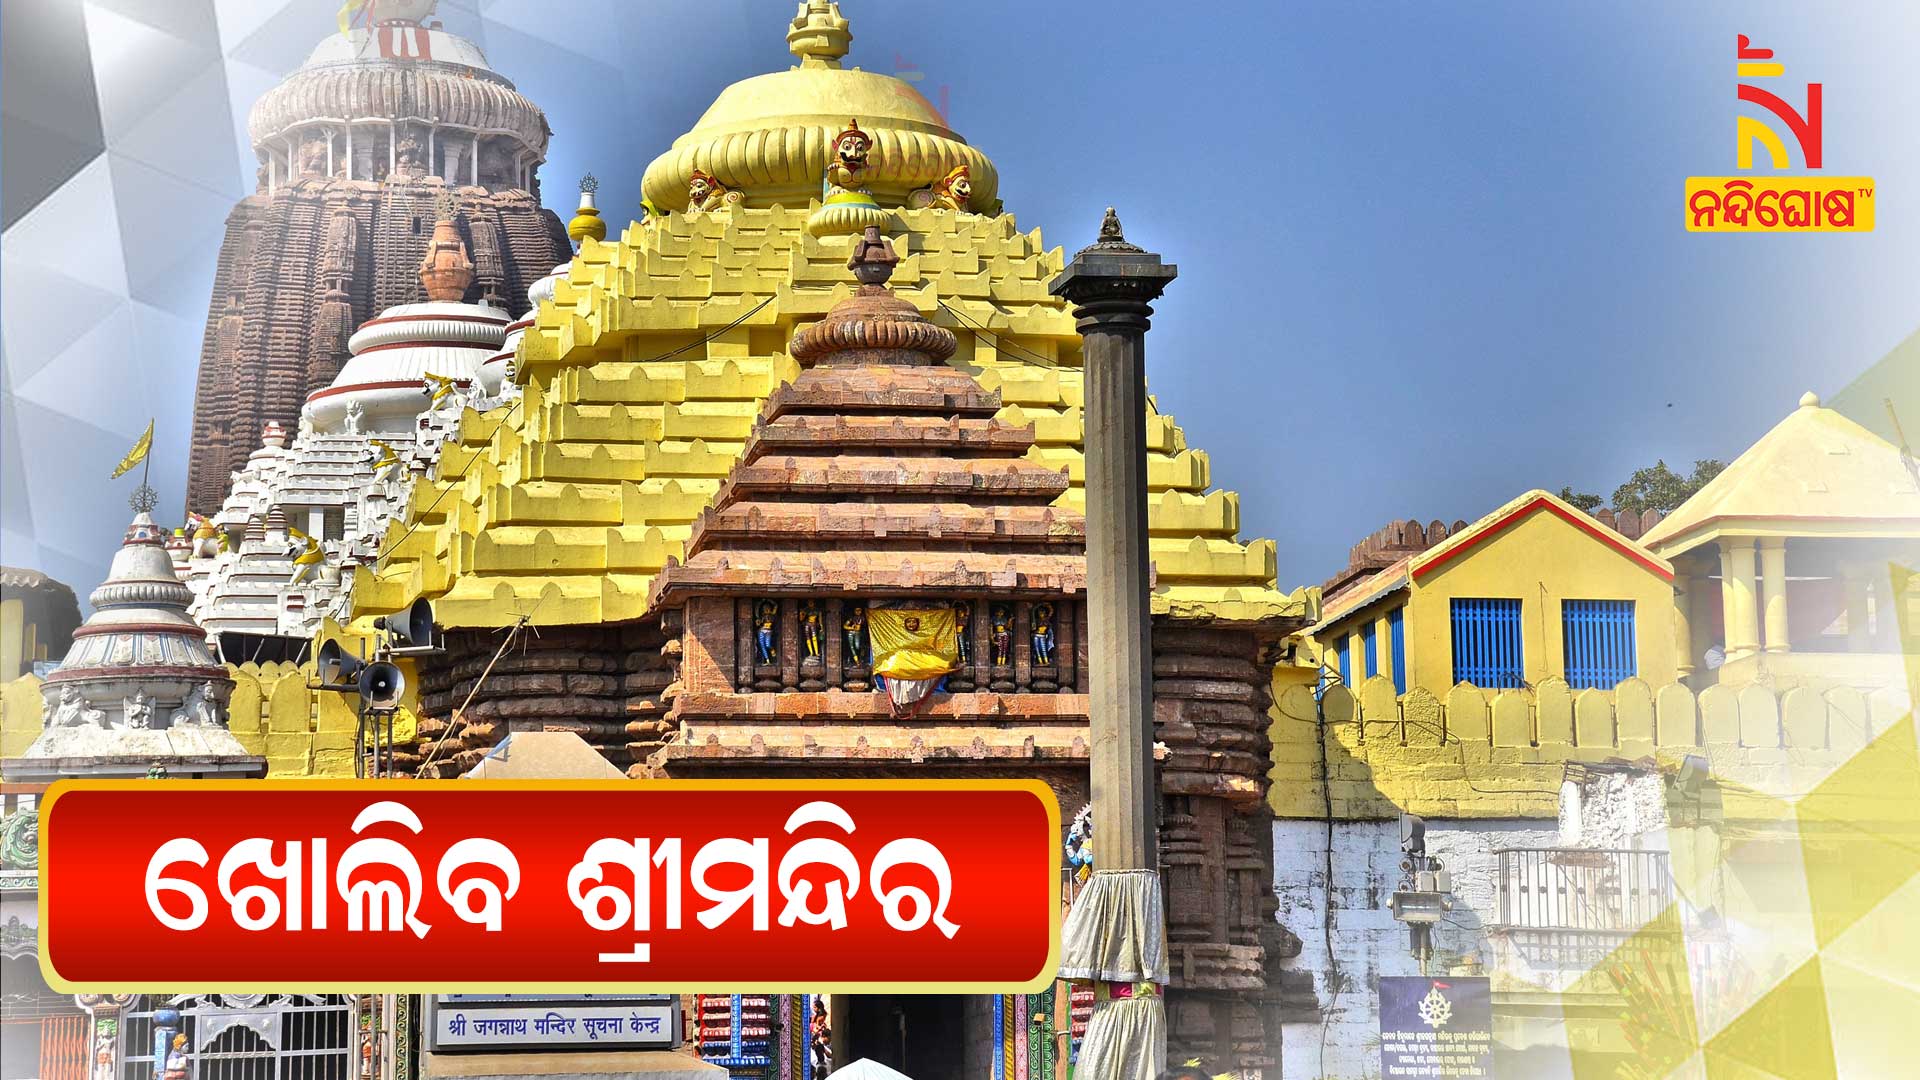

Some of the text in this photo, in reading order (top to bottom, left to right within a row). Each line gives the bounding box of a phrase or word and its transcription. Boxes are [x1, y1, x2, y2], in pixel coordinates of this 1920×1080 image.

[448, 1011, 661, 1040] श्री जगन्नाथ मन्दिर सूचना केन्द्र
